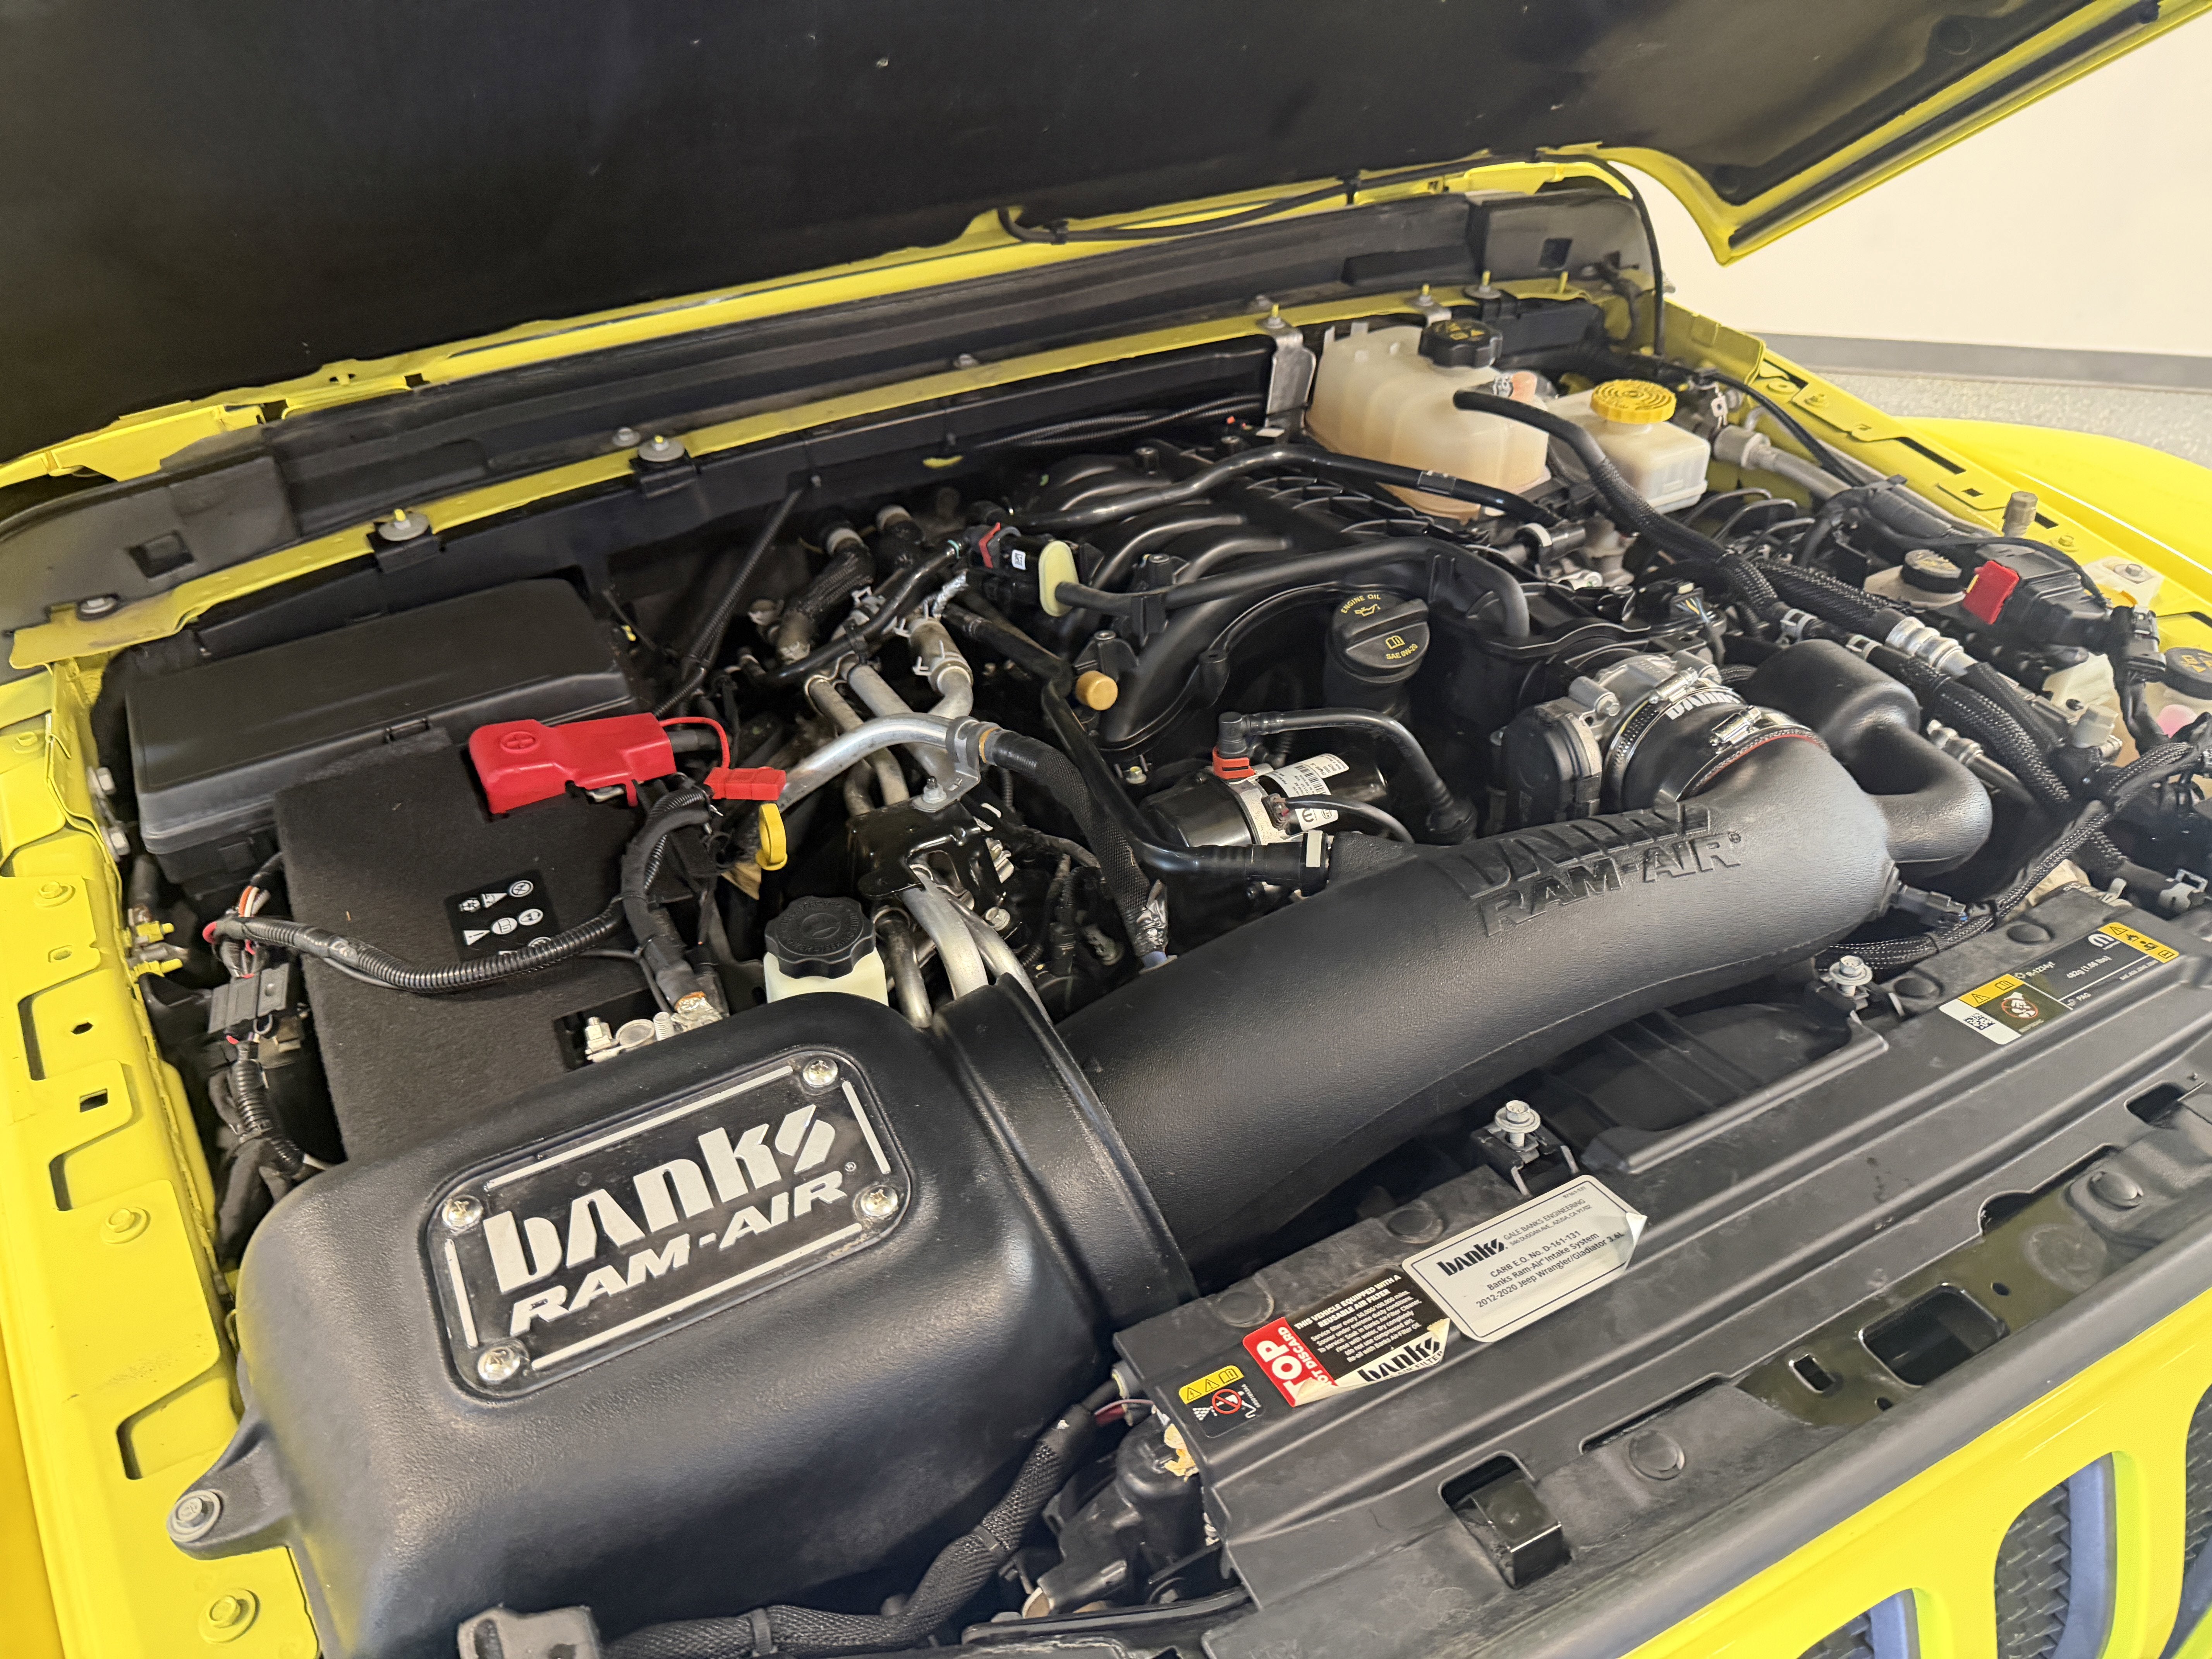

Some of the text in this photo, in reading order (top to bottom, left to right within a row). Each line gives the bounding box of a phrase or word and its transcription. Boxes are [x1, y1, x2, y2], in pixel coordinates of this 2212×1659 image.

[1341, 595, 1365, 613] ENGINE
[1401, 644, 1418, 657] 0W-20
[2076, 993, 2091, 1001] PAG
[483, 1104, 835, 1293] banks
[1503, 1199, 1586, 1240] GALE BANKS ENGINEERING
[1518, 1229, 1541, 1242] DUGGAN
[1436, 1238, 1508, 1276] banks
[1475, 1232, 1625, 1308] 2012-2020 Jeep Wrangler/Gladiator 3.6L
[1487, 1276, 1513, 1290] Banks
[1544, 1247, 1570, 1262] Intake
[1569, 1233, 1599, 1249] System
[1490, 1231, 1580, 1277] CARB E.O. No. D-161-131
[1294, 1318, 1313, 1329] THIS
[1310, 1304, 1342, 1321] VEHICLE
[1340, 1287, 1376, 1307] EQUIPPED
[1374, 1277, 1395, 1290] WITH
[1317, 1289, 1391, 1328] REUSABLE AIR FILTER
[1310, 1329, 1331, 1341] Service
[1342, 1316, 1358, 1326] every
[1316, 1334, 1336, 1346] Sooner
[1335, 1326, 1351, 1337] under
[1350, 1316, 1373, 1329] extreme
[1372, 1309, 1387, 1319] dusty
[1335, 1343, 1350, 1352] rinse
[1348, 1337, 1362, 1345] with
[1386, 1310, 1414, 1327] completely
[1344, 1331, 1359, 1340] Soak
[1363, 1320, 1381, 1330] Banks
[1362, 1346, 1376, 1354] with
[1374, 1338, 1391, 1348] Banks
[1373, 1322, 1405, 1341] compressed
[1278, 1327, 1317, 1369] DISCARD
[1357, 1337, 1440, 1382] banks
[1417, 1350, 1443, 1368] FILTER
